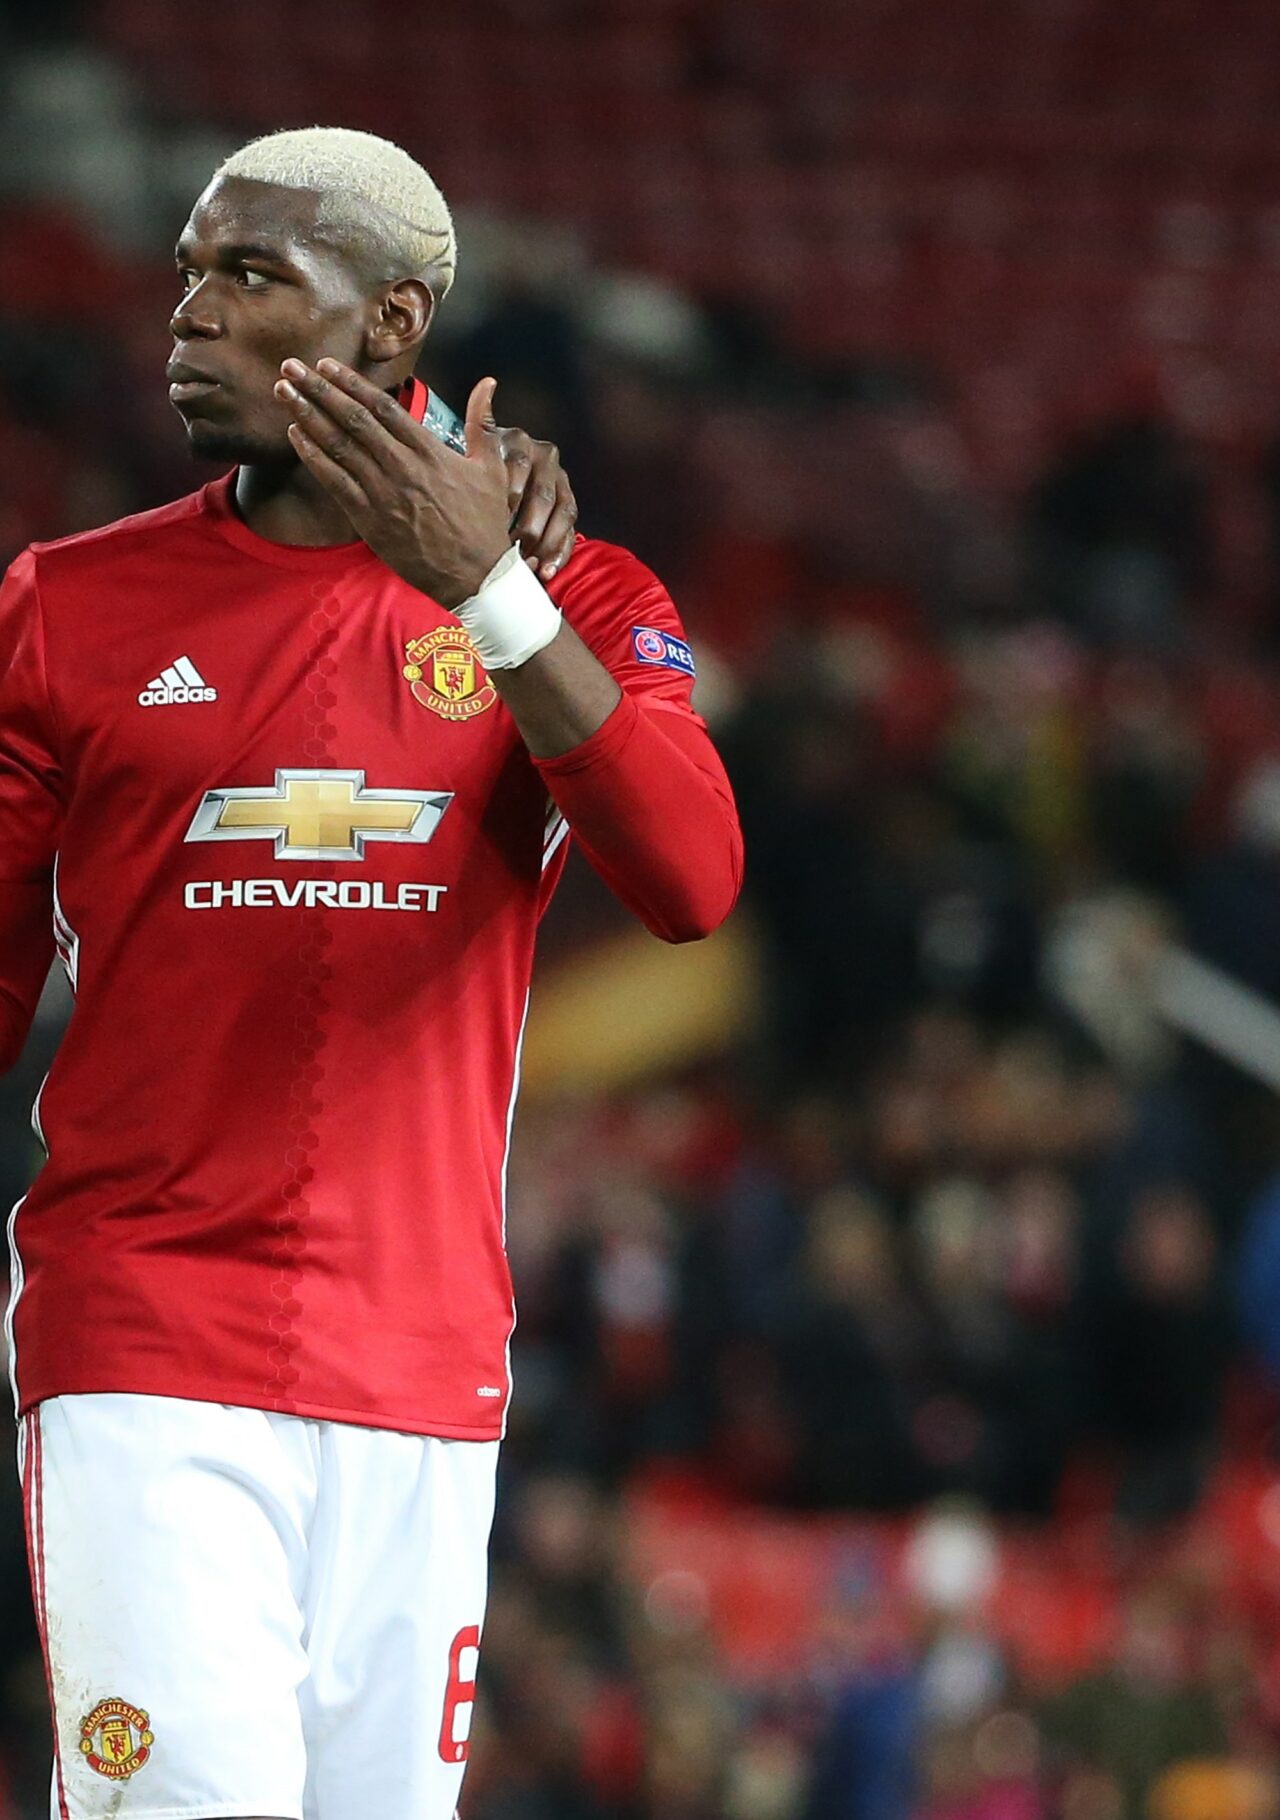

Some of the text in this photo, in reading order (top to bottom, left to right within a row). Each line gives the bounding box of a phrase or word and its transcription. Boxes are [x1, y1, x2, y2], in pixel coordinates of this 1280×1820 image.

[414, 632, 477, 660] MANCHES
[137, 686, 218, 707] adidas
[427, 694, 483, 714] UNITED
[184, 879, 448, 912] CHEVROLET
[85, 1703, 144, 1732] MANCHESTER
[98, 1758, 140, 1775] UNITED
